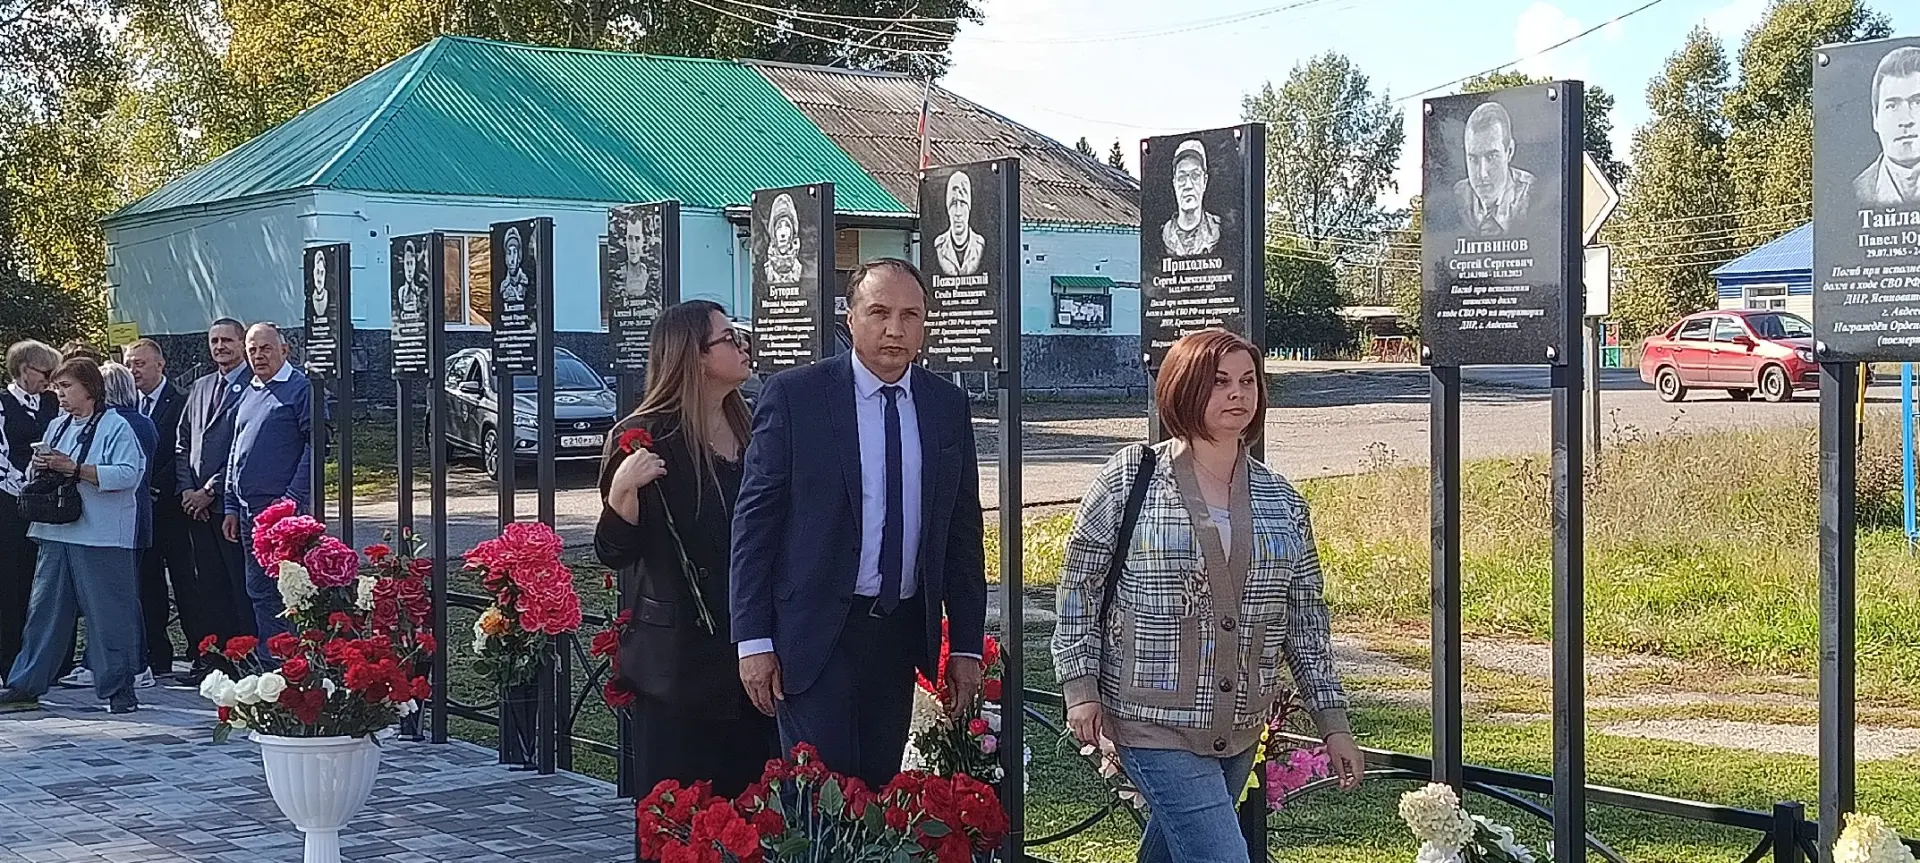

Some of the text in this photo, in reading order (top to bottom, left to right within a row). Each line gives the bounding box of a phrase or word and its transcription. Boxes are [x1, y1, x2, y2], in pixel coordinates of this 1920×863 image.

[1454, 239, 1528, 254] Литвинов
[1858, 234, 1898, 247] Павел
[1866, 247, 1907, 258] 29.07.1965
[1162, 258, 1223, 275] Приходько
[1449, 258, 1533, 271] Сергей Сергеевич
[1832, 266, 1861, 277] Погиб
[1862, 267, 1880, 279] при
[932, 272, 989, 289] Пожарицкий
[1153, 274, 1233, 288] Сергей Александрович
[1823, 276, 1920, 291] долга в ходе СВО РФ
[1450, 285, 1473, 294] Погиб
[1473, 286, 1487, 296] при
[1843, 293, 1920, 306] ДНР, Ясиноват
[1458, 308, 1475, 317] СВО
[1475, 308, 1487, 317] РФ
[1891, 306, 1920, 317] Авдее
[1833, 320, 1920, 334] Награждён Орден
